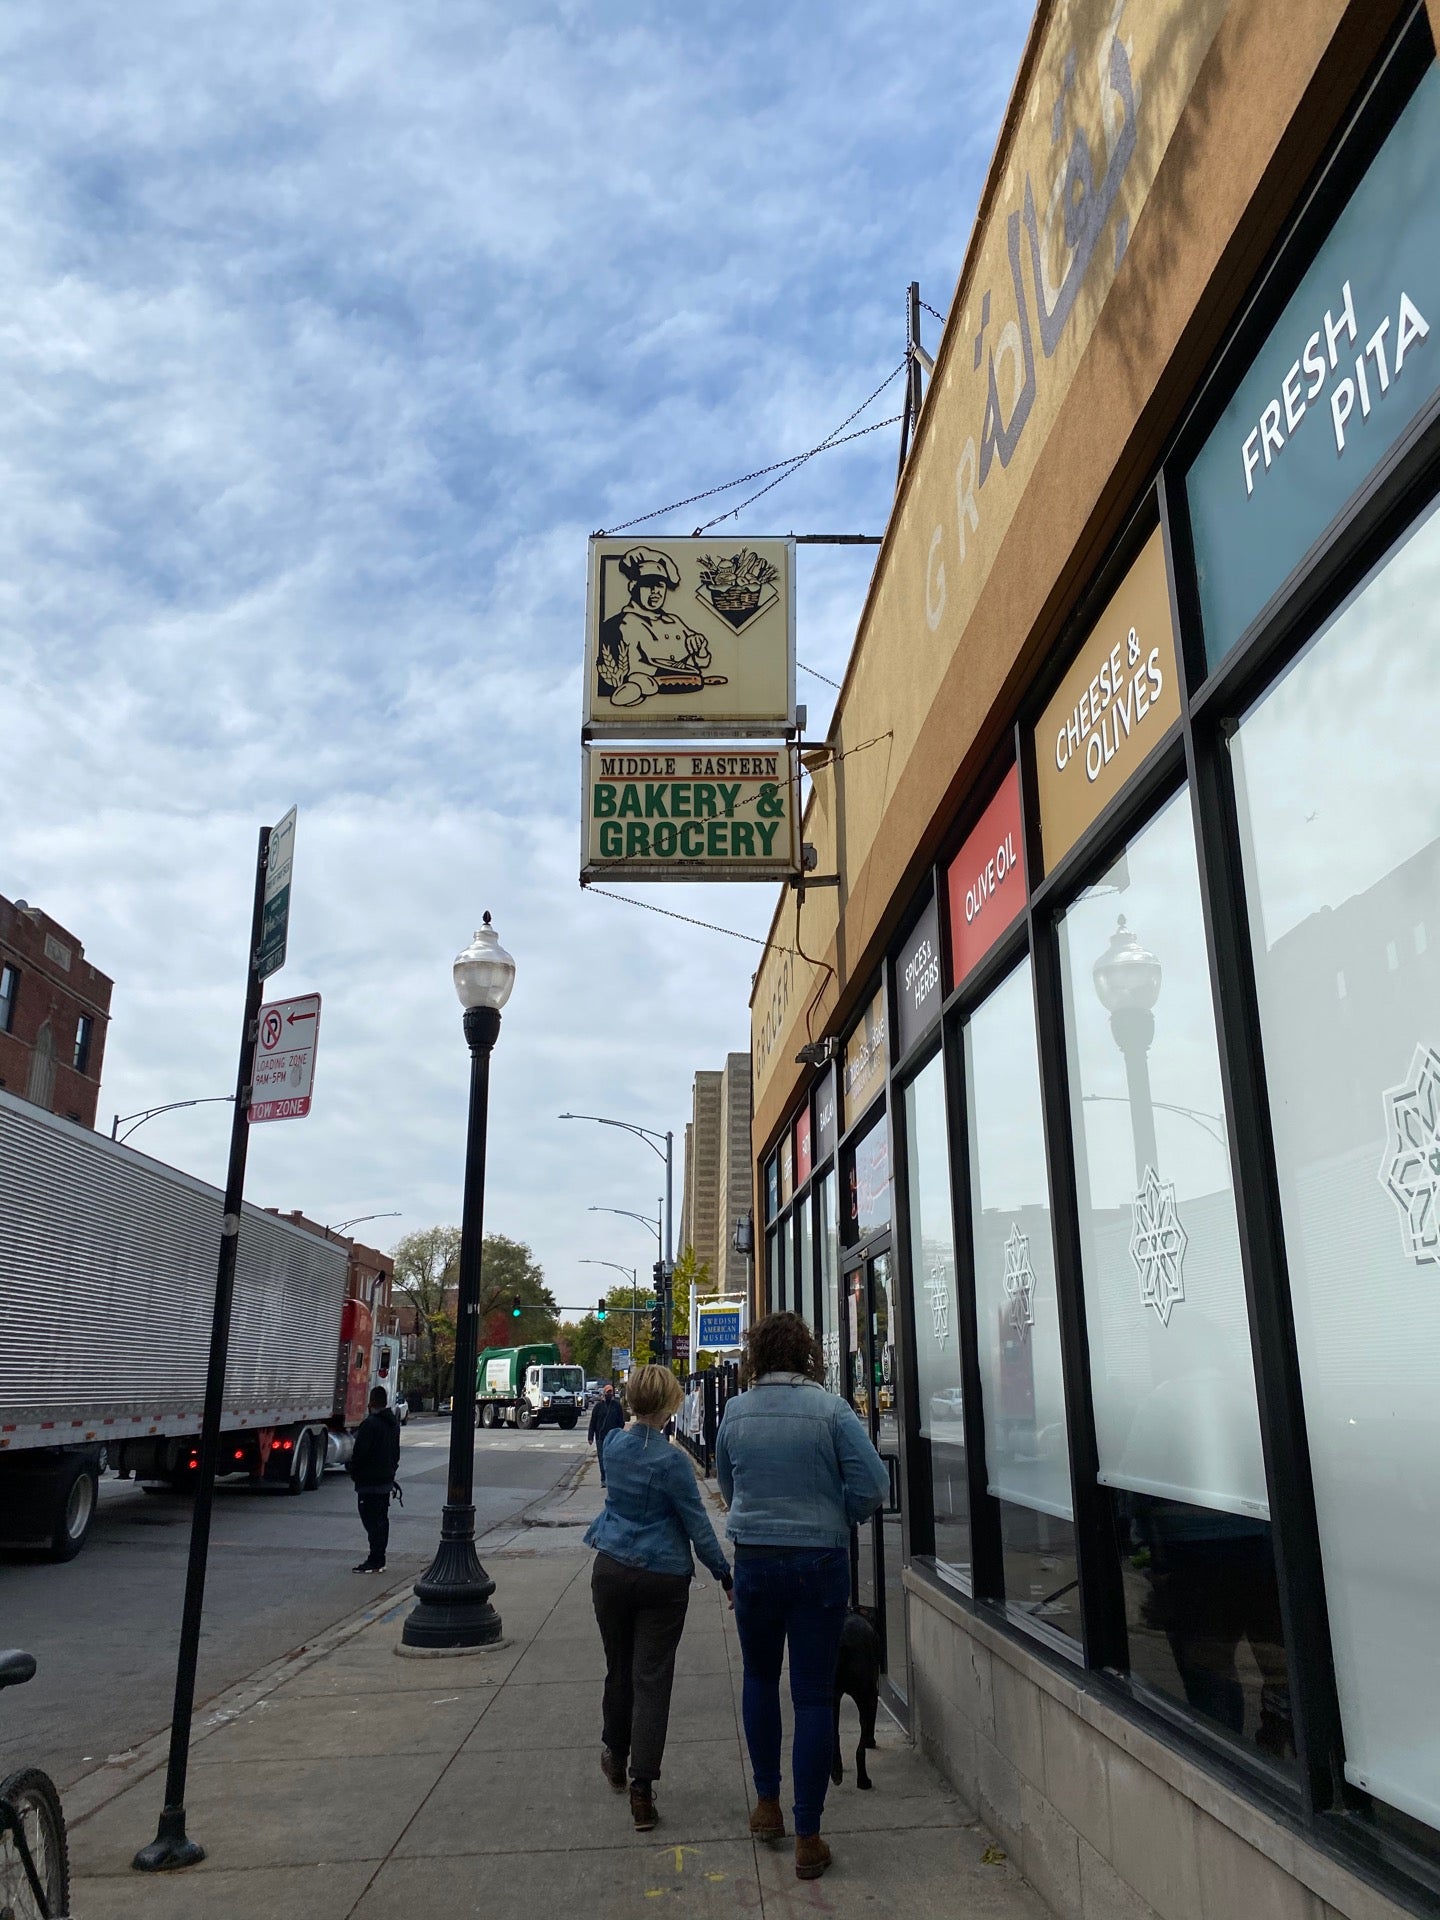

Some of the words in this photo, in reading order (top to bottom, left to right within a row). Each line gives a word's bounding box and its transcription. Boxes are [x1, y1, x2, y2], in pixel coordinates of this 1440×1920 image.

[1241, 279, 1358, 495] FRESH
[1330, 291, 1430, 452] PITA
[1056, 641, 1124, 770] CHEESE
[1127, 626, 1141, 666] &
[1086, 647, 1163, 781] OLIVES
[600, 758, 676, 775] MIDDLE
[691, 758, 777, 775] EASTERN
[593, 783, 742, 818] BAKERY
[756, 782, 786, 818] &
[600, 820, 780, 858] GROCERY
[965, 857, 995, 922] OLIVE
[996, 832, 1016, 880] OIL
[905, 940, 927, 991] SPICES
[914, 955, 939, 1010] HERBS
[756, 936, 796, 1081] GROCERY
[255, 1071, 287, 1086] 9AM-5PM
[256, 1057, 286, 1072] LOADING
[289, 1053, 308, 1067] ZONE
[252, 1103, 273, 1119] TOW
[276, 1099, 304, 1117] ZONE
[702, 1317, 737, 1325] SWEDISH
[702, 1333, 737, 1342] MUSEUM
[703, 1325, 737, 1334] AMERICAN
